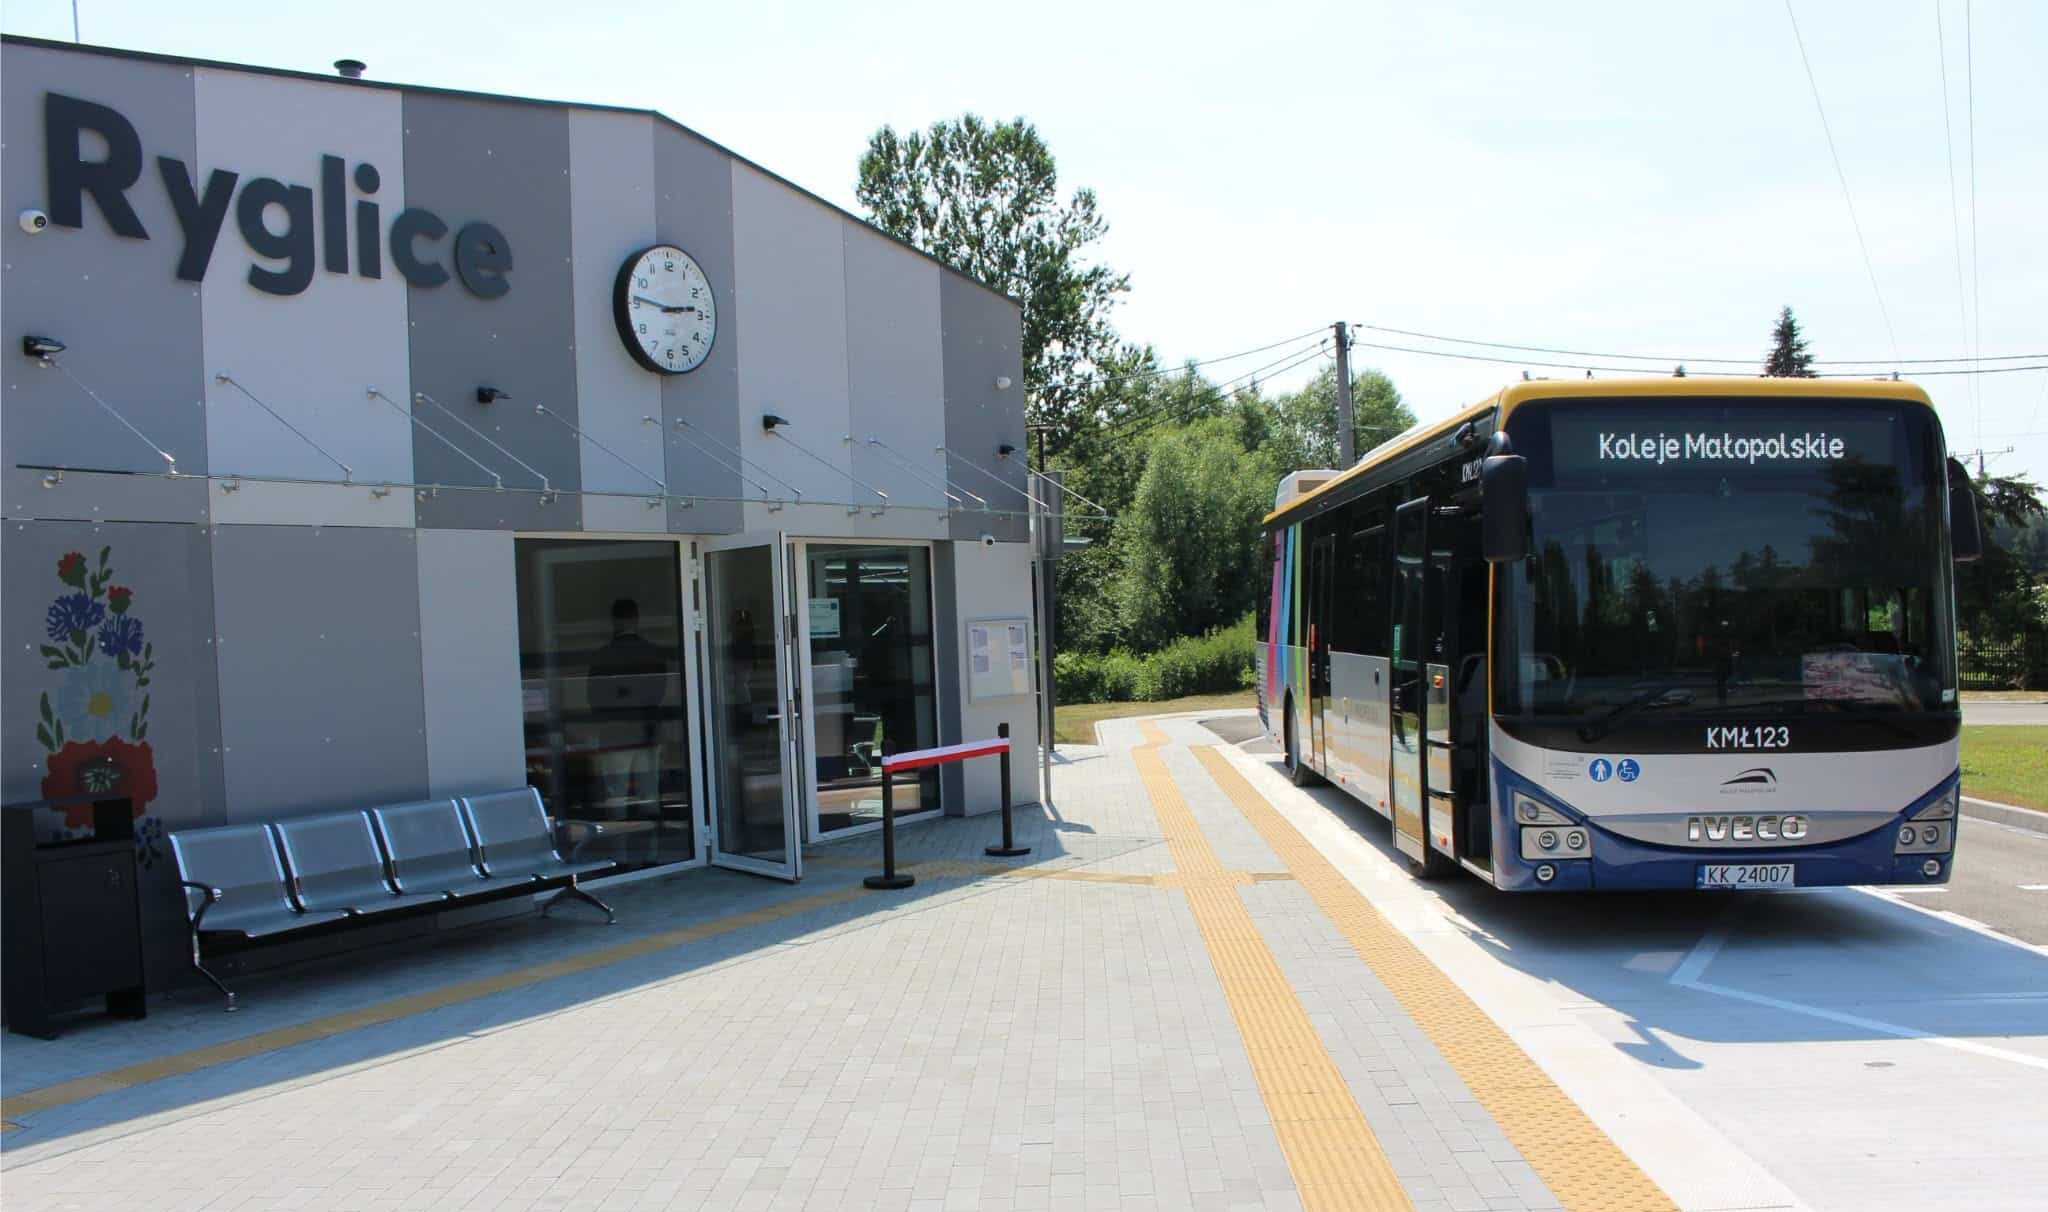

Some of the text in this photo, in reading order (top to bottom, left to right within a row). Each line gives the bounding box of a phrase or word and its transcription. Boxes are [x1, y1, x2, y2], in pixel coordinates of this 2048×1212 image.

[45, 91, 513, 300] Ryglice
[649, 263, 656, 276] 11
[664, 261, 674, 273] 12
[637, 278, 649, 290] 10
[691, 287, 699, 299] 2
[697, 310, 704, 321] 3
[639, 323, 648, 335] 8
[692, 332, 700, 343] 4
[651, 340, 660, 352] 7
[681, 345, 690, 356] 5
[666, 349, 675, 360] 6
[1599, 432, 1845, 465] Koleje Małopolskie
[1707, 726, 1790, 748] KMŁ123
[1688, 814, 1808, 841] IVECO
[1708, 866, 1790, 883] KK 24007
